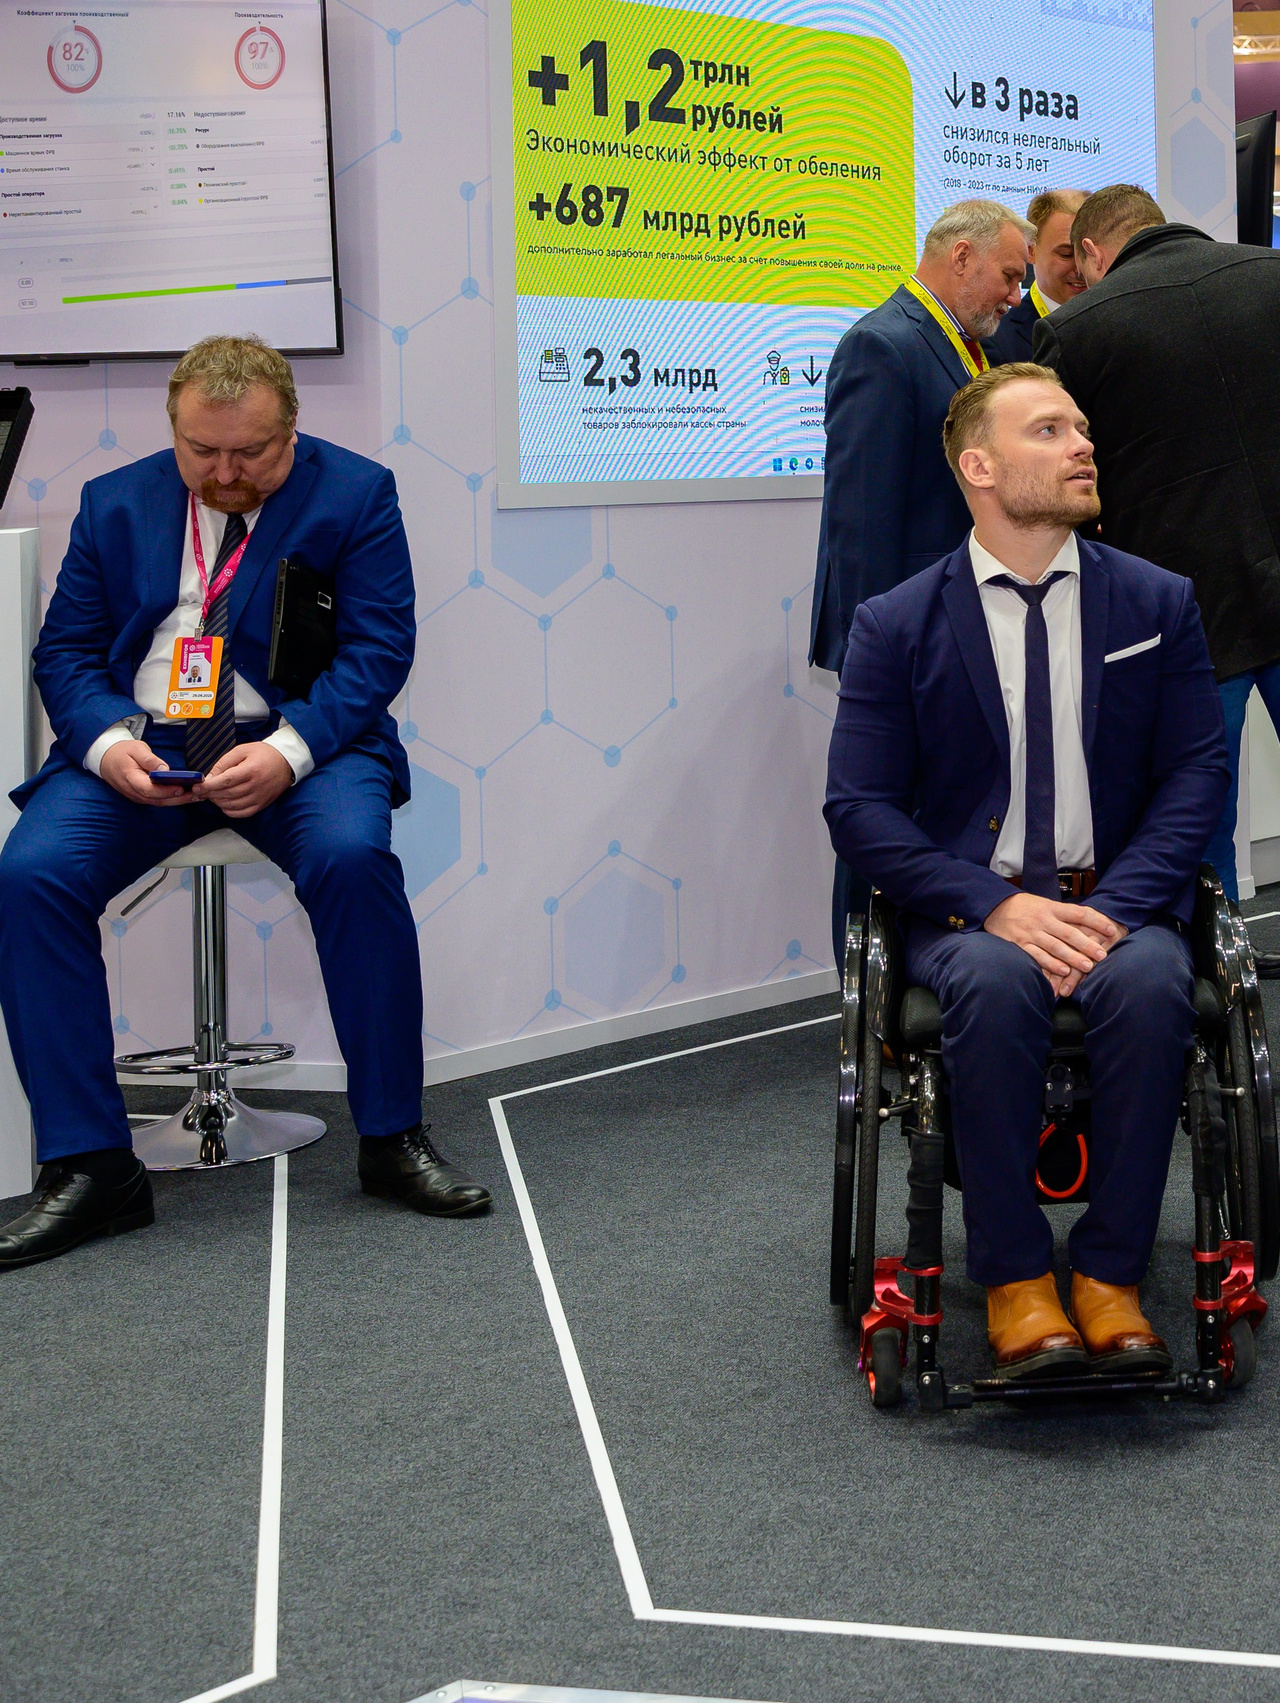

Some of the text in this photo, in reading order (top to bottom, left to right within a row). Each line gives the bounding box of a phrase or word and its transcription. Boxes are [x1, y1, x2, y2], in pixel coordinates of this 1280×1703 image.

[528, 39, 686, 137] +1,2
[690, 59, 750, 88] трлн
[994, 76, 1010, 112] 3
[1018, 87, 1079, 122] раза
[691, 103, 783, 134] рублей
[943, 123, 1101, 155] снизился нелегальный
[526, 128, 882, 182] Экономический эффект от обеления
[943, 147, 1050, 173] оборот за 5 лет
[943, 177, 962, 189] (2018
[967, 179, 985, 190] 2023
[992, 184, 1000, 192] по
[1001, 185, 1026, 193] данным
[528, 182, 806, 242] +687 млрд рублей
[527, 244, 604, 257] дополнительно
[605, 249, 653, 260] заработал
[655, 250, 703, 263] легальный
[704, 252, 736, 264] бизнес
[738, 256, 747, 264] за
[748, 256, 768, 266] счет
[769, 258, 817, 268] повышения
[818, 258, 844, 270] своей
[844, 261, 865, 272] доли
[582, 346, 718, 397] 2,3 млрд
[581, 403, 727, 415] некачественных и небезопасных
[582, 419, 747, 432] товаров заблокировали кассы страны
